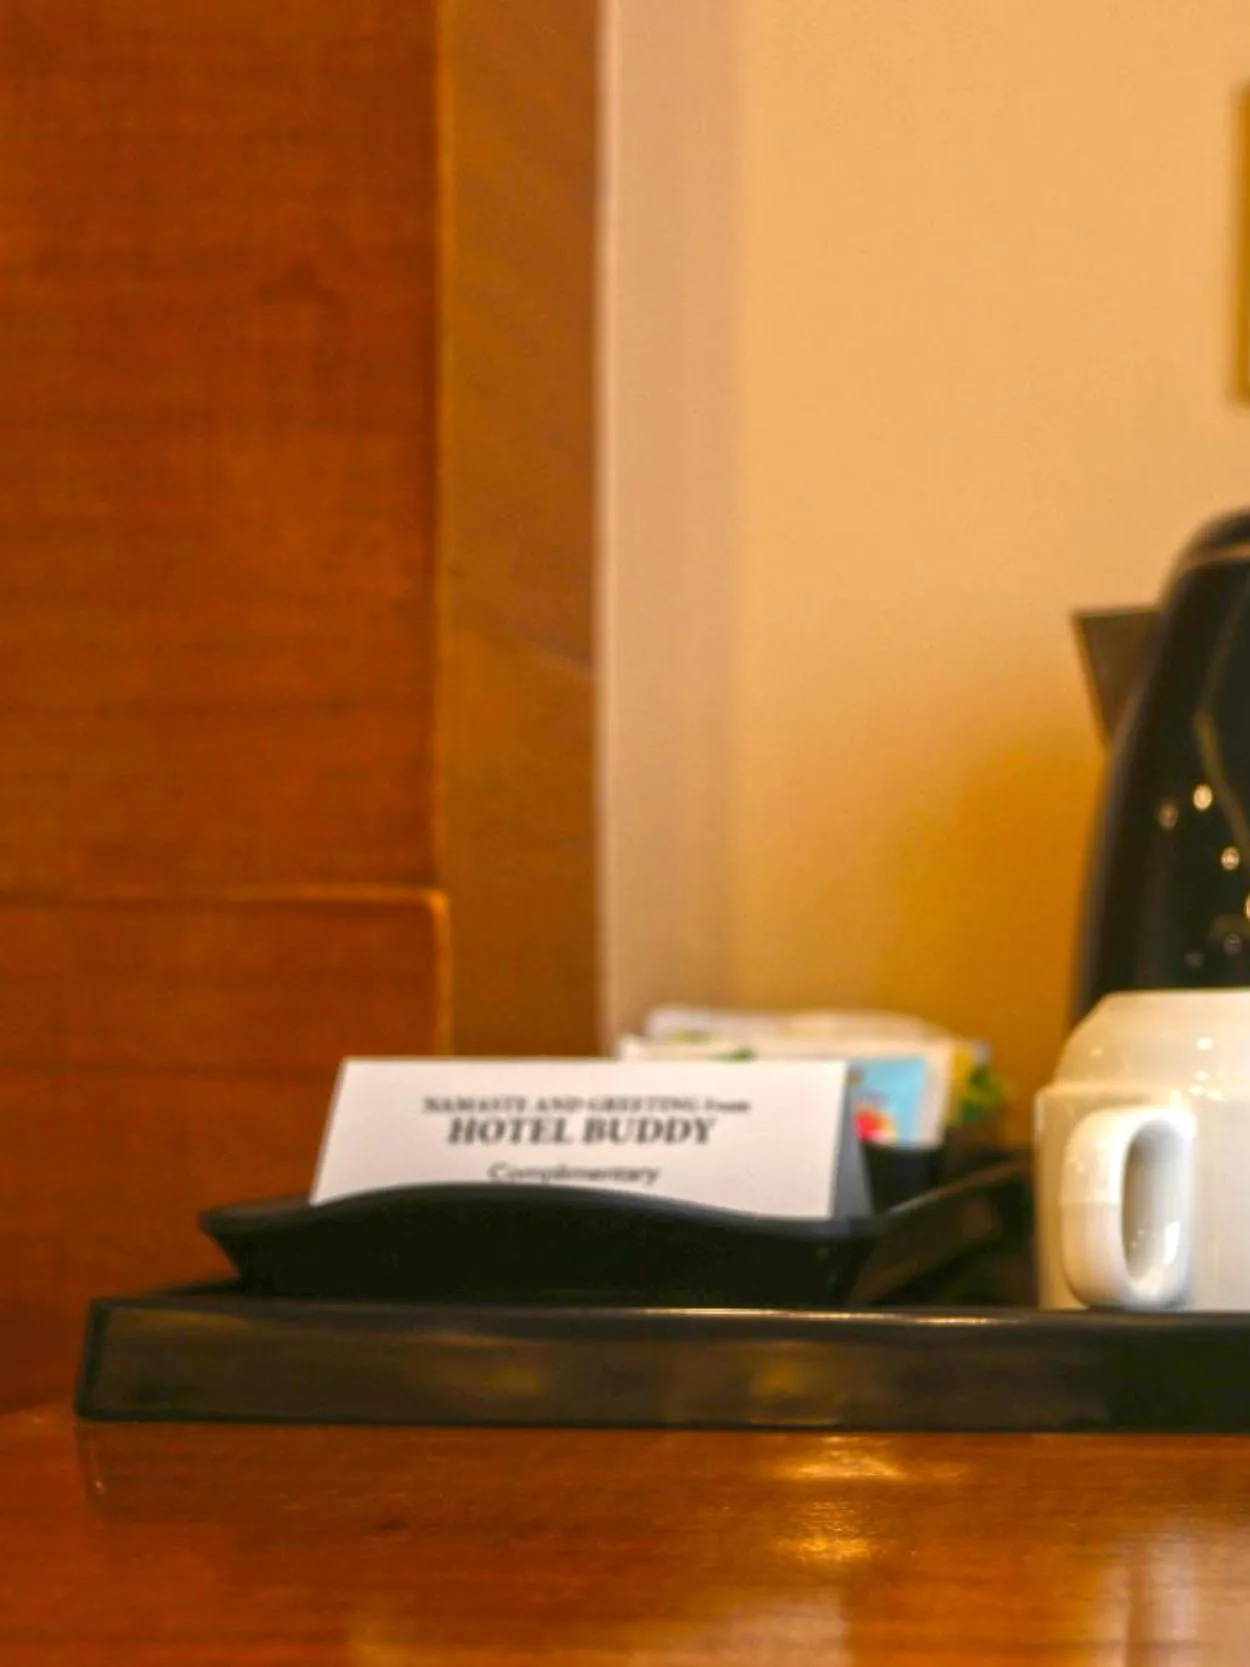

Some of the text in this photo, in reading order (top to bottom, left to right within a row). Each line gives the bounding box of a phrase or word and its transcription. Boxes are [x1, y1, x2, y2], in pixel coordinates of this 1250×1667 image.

[423, 1096, 527, 1113] NAMASTE
[535, 1096, 584, 1113] AND
[447, 1116, 717, 1145] HOTEL BUDDY
[487, 1161, 660, 1185] Complimentary
